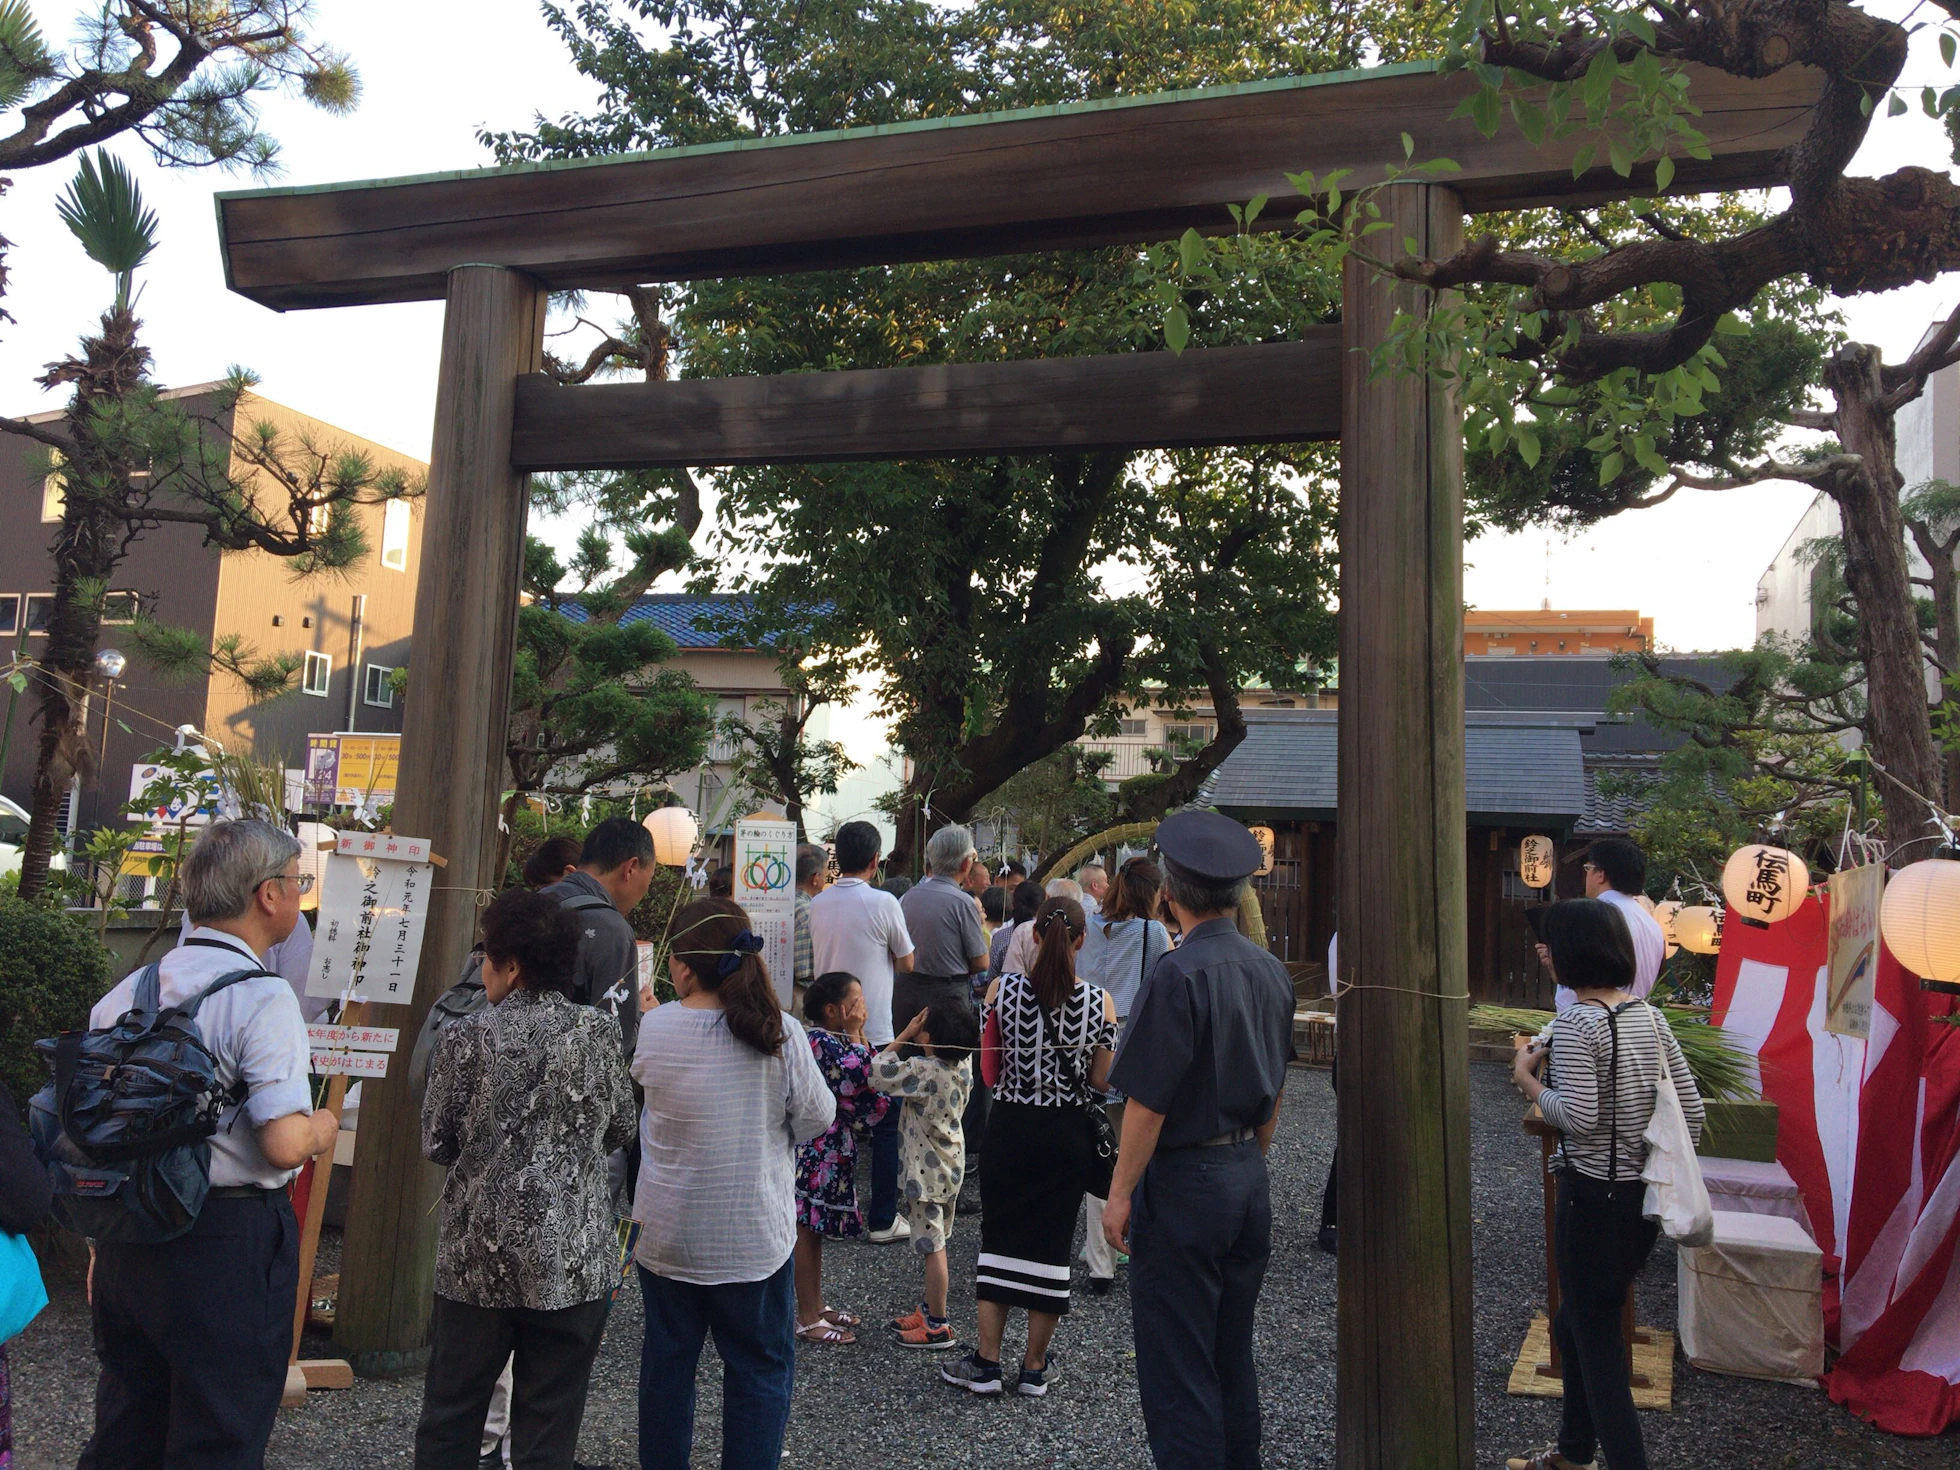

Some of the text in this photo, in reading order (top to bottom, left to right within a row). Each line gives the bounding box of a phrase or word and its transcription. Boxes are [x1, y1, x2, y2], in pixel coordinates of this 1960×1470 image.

[340, 838, 421, 856] 新御神印
[1524, 838, 1540, 882] 鈴之御前社
[1745, 849, 1789, 914] 伝馬町
[388, 865, 418, 993] 令和元年七月三十一日
